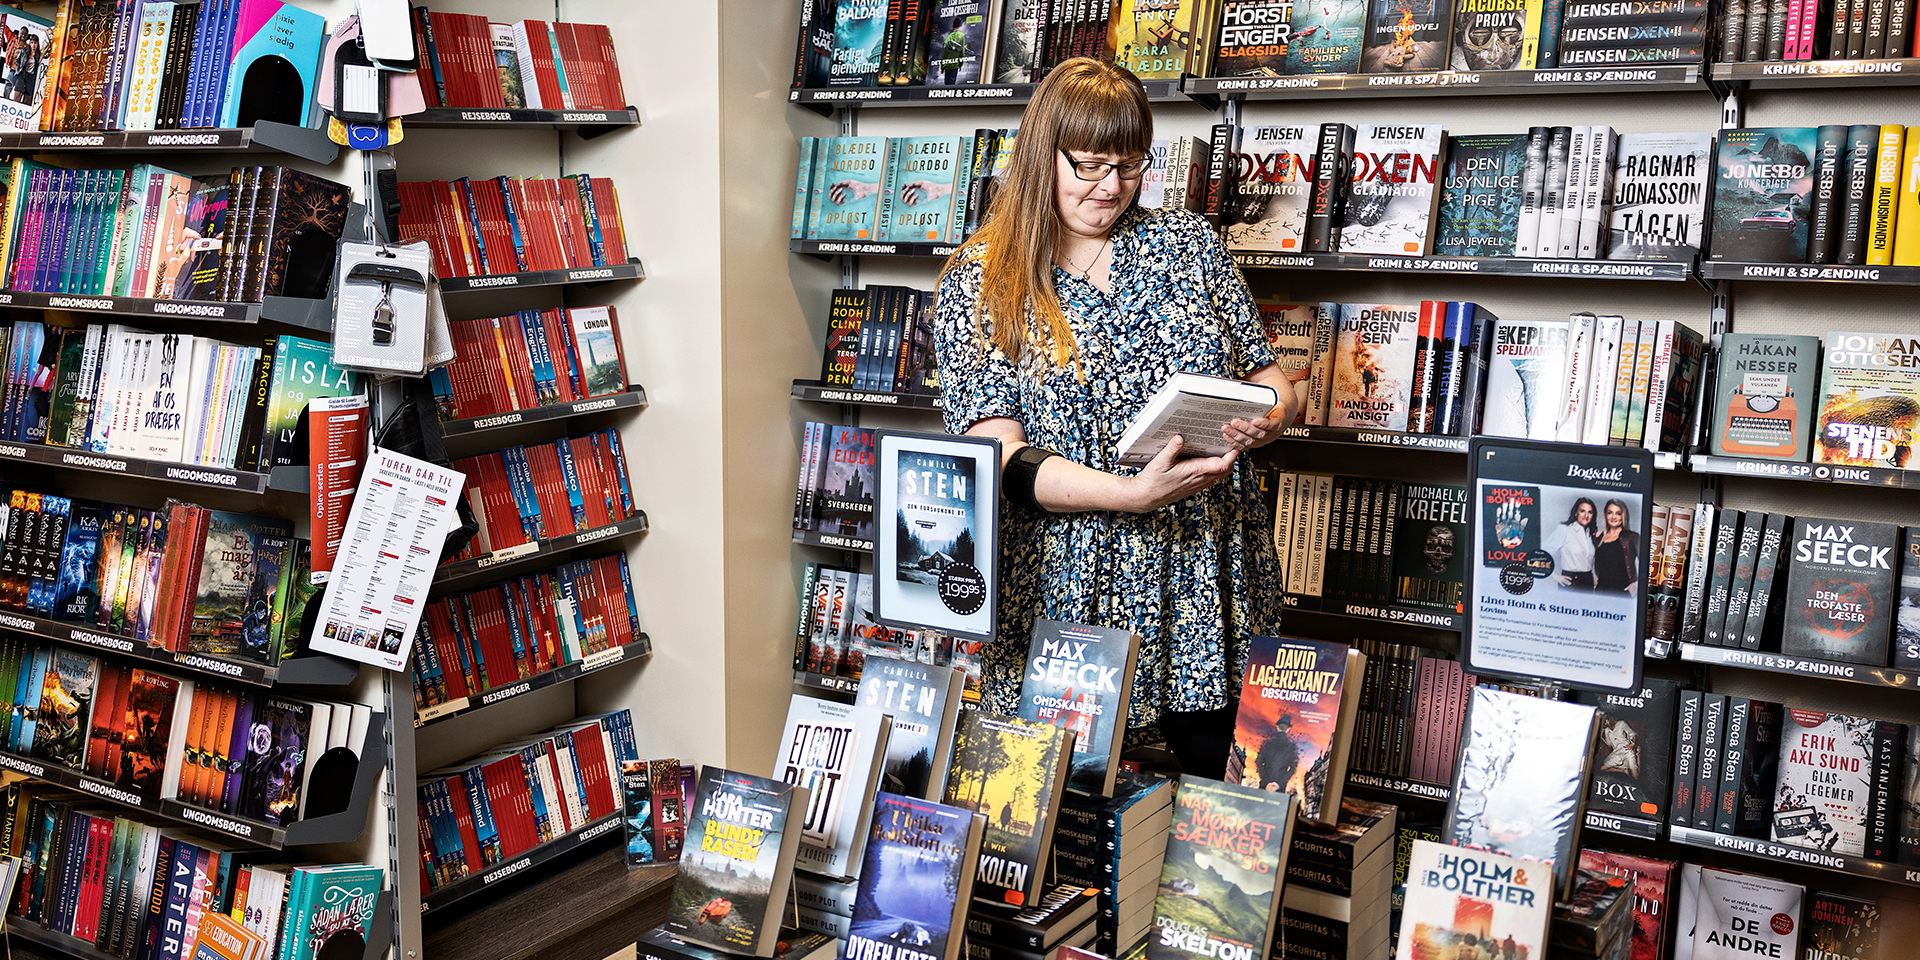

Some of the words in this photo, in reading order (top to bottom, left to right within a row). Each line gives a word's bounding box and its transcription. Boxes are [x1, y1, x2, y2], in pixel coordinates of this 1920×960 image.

[275, 13, 295, 26] pixie
[1135, 9, 1176, 22] ENKE
[1223, 4, 1290, 25] HORST
[1475, 12, 1516, 27] PROXY
[273, 24, 293, 36] lever
[1220, 25, 1290, 47] ENGER
[1376, 25, 1406, 34] INGEN
[1408, 23, 1439, 32] UDVEJ
[1570, 25, 1629, 42] JENSEN
[269, 35, 295, 49] stadig
[1133, 45, 1169, 56] SARA
[1298, 46, 1349, 55] FAMILIENS
[833, 48, 865, 62] Farligt
[1219, 45, 1288, 58] SLAGSIDE
[1303, 54, 1342, 63] SYNDER
[831, 62, 880, 75] øjenvidne
[1763, 65, 1805, 74] KRIMI
[1807, 65, 1818, 74] &
[1820, 62, 1902, 74] SPÆNDING
[813, 91, 838, 100] KRIMI
[838, 91, 845, 99] &
[845, 90, 892, 100] SPÆNDING
[462, 112, 511, 121] REJSEBØGER
[563, 113, 607, 122] REJSEBØGER
[39, 136, 104, 146] UNGDOMSBØGER
[148, 135, 219, 145] UNGDOMSBØGER
[1371, 126, 1425, 140] JENSEN
[835, 142, 877, 155] BLÆDEL
[833, 159, 875, 171] NORDBO
[1466, 157, 1499, 171] DEN
[1626, 154, 1696, 177] RAGNAR
[1723, 166, 1745, 179] JO
[1748, 164, 1805, 179] NESBØ
[1445, 175, 1519, 189] USYNLIGE
[1738, 179, 1790, 189] KONGERIGET
[1238, 186, 1304, 197] GLADIATOR
[1462, 194, 1497, 207] PIGE
[1616, 181, 1701, 205] JÓNASSON
[826, 211, 867, 226] OPLØST
[1874, 186, 1891, 250] JALOUSIMANDEN
[1622, 210, 1689, 247] TÅGEN
[1445, 237, 1466, 246] LISA
[1468, 237, 1504, 246] JEWELL
[569, 269, 614, 280] REJSEBØGER
[49, 297, 113, 310] UNGDOMSBØGER
[584, 319, 609, 330] LONDON
[1360, 309, 1417, 323] DENNIS
[527, 327, 541, 364] England
[1739, 341, 1797, 357] HÅKAN
[341, 355, 380, 367] ELEKTRONISK
[1616, 342, 1635, 394] KNUST
[1736, 360, 1798, 373] NESSER
[160, 372, 173, 389] EN
[256, 354, 272, 406] ERAGON
[289, 358, 351, 391] ISLA
[152, 393, 163, 409] AF
[164, 393, 176, 409] OS
[572, 399, 616, 413] REJSEBØGER
[1335, 400, 1370, 410] MAND
[1372, 403, 1405, 412] UDEN
[145, 413, 181, 431] DRÆBER
[474, 413, 523, 428] REJSEBØGER
[1347, 411, 1390, 422] ANSIGT
[1827, 422, 1913, 441] STENENS
[1846, 438, 1897, 460] TID
[63, 454, 127, 471] UNGDOMSBØGER
[916, 459, 957, 470] CAMILLA
[167, 468, 237, 486] UNGDOMSBØGER
[381, 457, 412, 473] TUREN
[416, 468, 434, 481] GÅR
[438, 475, 452, 487] TIL
[521, 462, 531, 483] Cuba
[564, 453, 578, 492] Mexico
[1567, 463, 1623, 481] Bog&idé
[316, 462, 324, 519] Oplev-serien
[906, 469, 967, 501] STEN
[1408, 486, 1454, 501] MICHAEL
[827, 500, 873, 513] SVENSKEREN
[576, 526, 619, 544] REJSEBØGER
[1805, 523, 1855, 543] MAX
[1795, 539, 1892, 570] SEECK
[564, 581, 577, 617] India
[1816, 590, 1838, 600] DEN
[1481, 596, 1504, 606] Line
[1507, 599, 1536, 611] Holm
[1539, 603, 1546, 611] &
[1549, 605, 1579, 616] Stine
[1582, 608, 1627, 622] Bolther
[1806, 598, 1862, 613] TROFASTE
[1346, 605, 1379, 618] KRIMI
[1379, 609, 1388, 619] &
[1389, 610, 1452, 626] SPÆNDING
[1828, 611, 1865, 623] LÆSER
[70, 630, 134, 652] UNGDOMSBØGER
[1041, 638, 1086, 662] MAX
[1275, 648, 1317, 670] DAVID
[1723, 652, 1763, 665] KRIMI
[1764, 657, 1775, 667] &
[1777, 658, 1854, 677] SPÆNDING
[883, 666, 928, 681] CAMILLA
[1029, 658, 1120, 693] SEECK
[1248, 664, 1340, 695] LAGERCRANTZ
[866, 677, 936, 717] STEN
[1032, 694, 1103, 716] ONDSKABENS
[1261, 687, 1319, 705] OBSCURITAS
[1606, 695, 1645, 709] FEXEUS
[1038, 707, 1060, 719] NET
[1682, 697, 1698, 742] Viveca
[1801, 733, 1836, 752] ERIK
[1679, 744, 1694, 776] Sten
[1789, 749, 1815, 766] AXL
[1819, 752, 1860, 773] SUND
[623, 776, 647, 784] Viveca
[628, 781, 646, 789] Sten
[1812, 770, 1842, 785] GLAS-
[79, 779, 141, 806] UNGDOMSBØGER
[1595, 780, 1637, 801] BOX
[1805, 783, 1854, 802] LEGEMER
[1873, 738, 1892, 843] KASTANJEMANDEN
[470, 785, 486, 828] Thailand
[1180, 792, 1212, 812] NÅR
[183, 808, 251, 836] UNGDOMSBØGER
[702, 798, 774, 830] HUNTER
[579, 817, 622, 842] REJSEBØGER
[705, 820, 763, 845] BLINDT
[1191, 811, 1276, 842] MØRKET
[1174, 822, 1265, 857] SÆNKER
[701, 836, 758, 862] RASERI
[804, 849, 838, 866] KORELITZ
[483, 858, 532, 884] REJSEBØGER
[1242, 856, 1270, 874] SIG
[1441, 853, 1513, 883] HOLM
[1513, 868, 1529, 886] &
[1426, 871, 1536, 908] BOLTHER
[164, 861, 190, 955] AFTER
[1156, 916, 1209, 937] DOUGLAS
[1731, 916, 1760, 936] DE
[212, 923, 243, 955] EDUCATION
[1159, 928, 1253, 960] SKELTON
[1705, 931, 1782, 959] ANDRE
